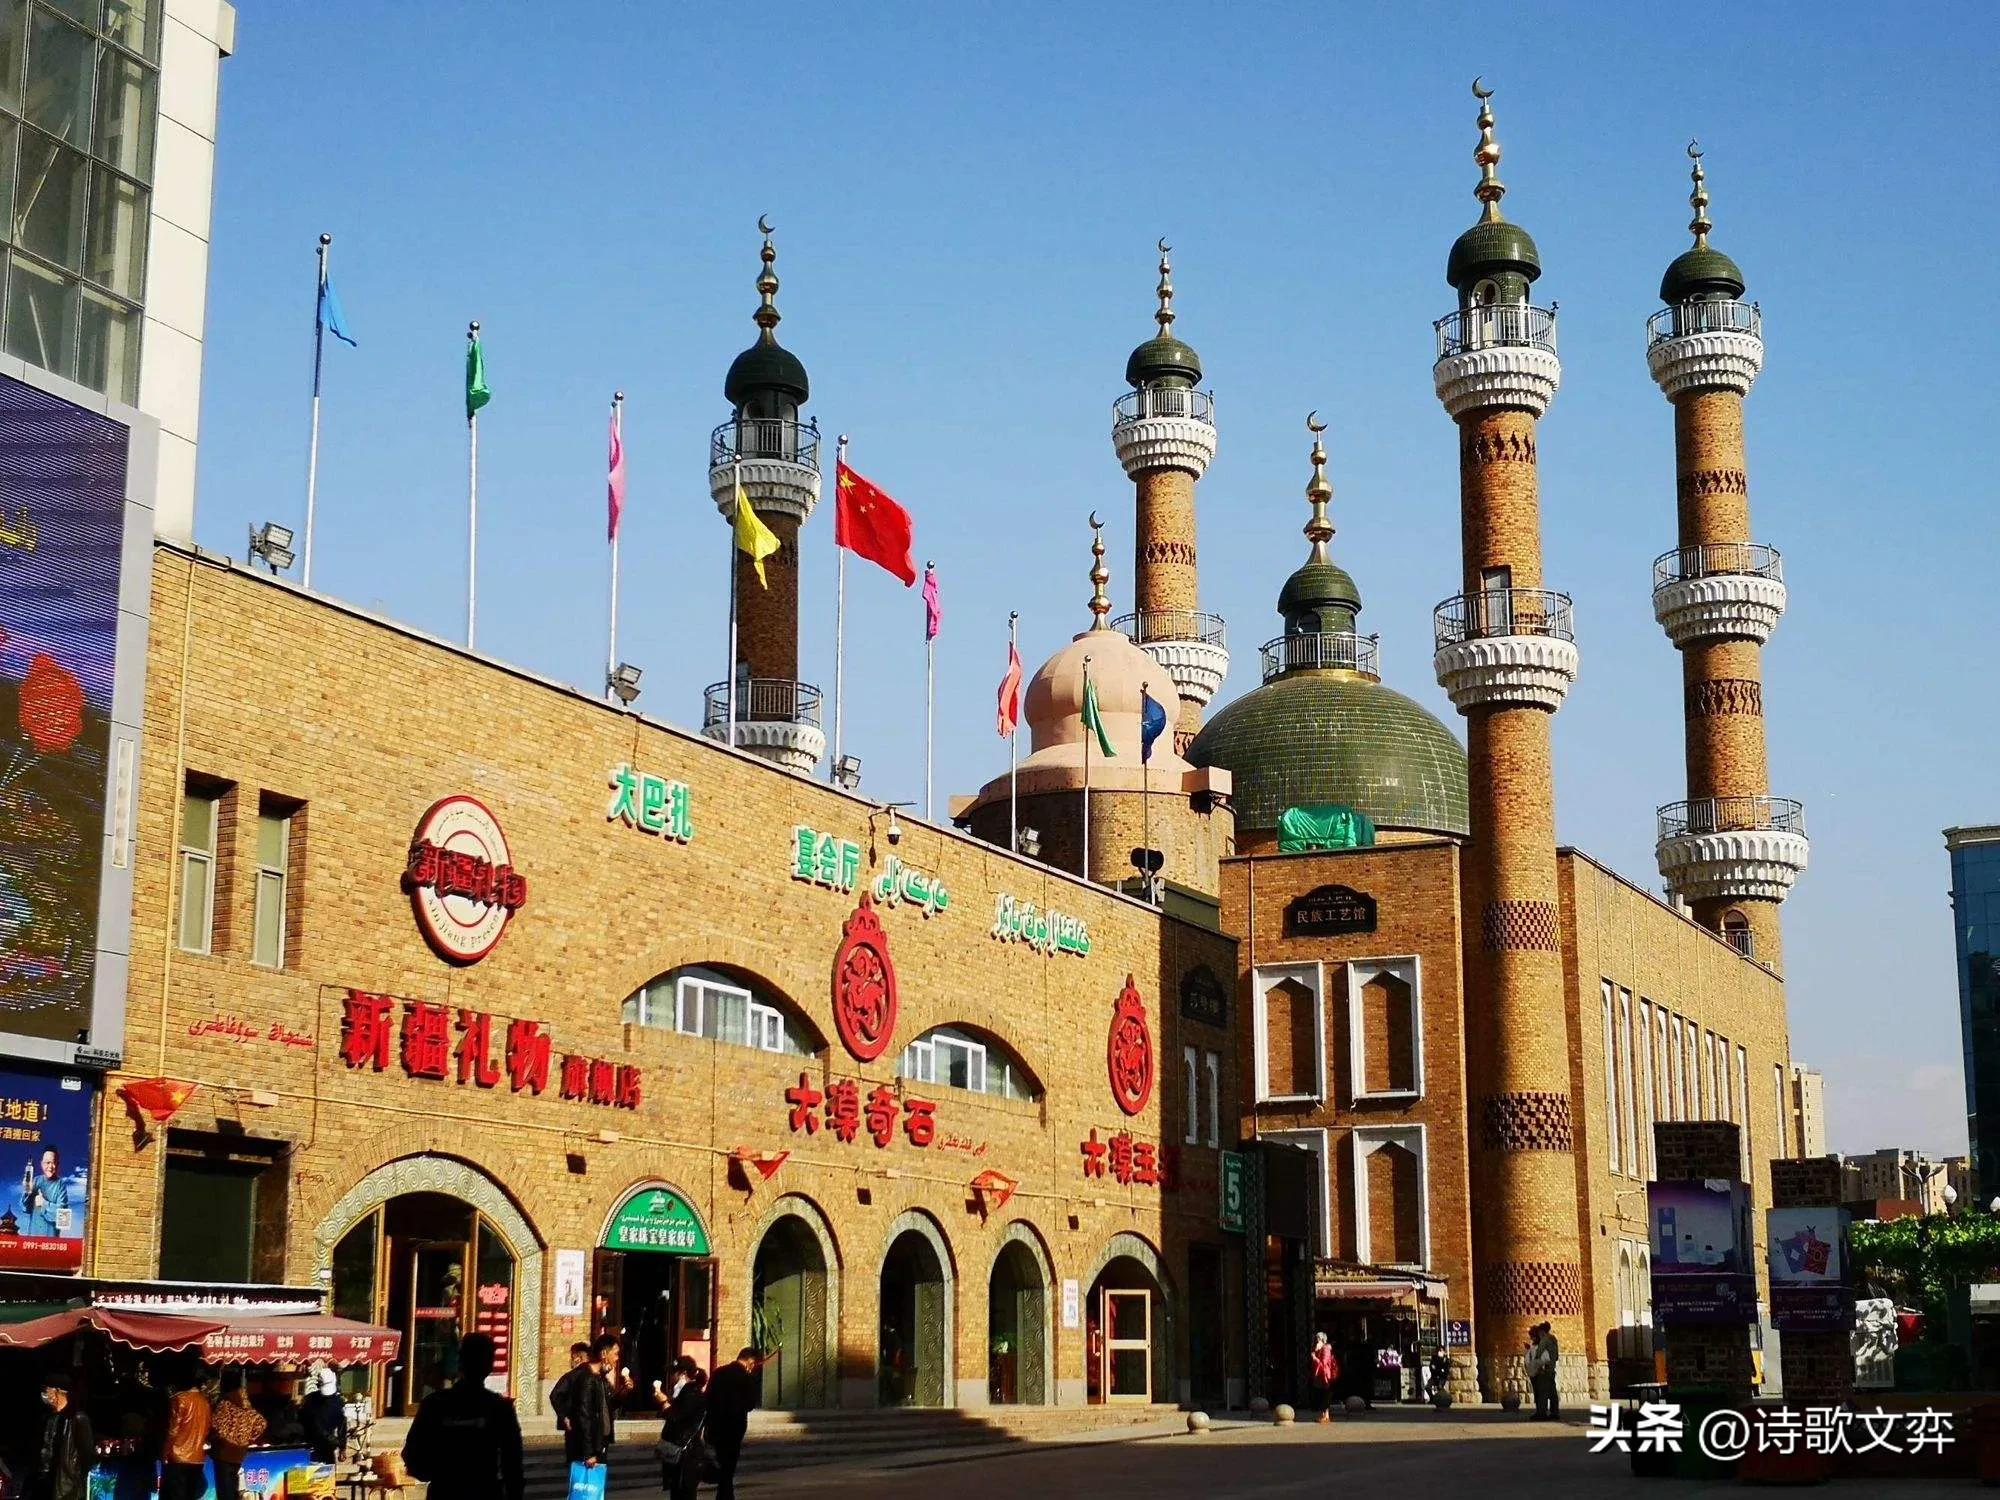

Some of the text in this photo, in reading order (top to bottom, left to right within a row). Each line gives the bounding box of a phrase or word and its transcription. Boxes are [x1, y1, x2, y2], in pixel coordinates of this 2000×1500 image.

[607, 763, 694, 842] 大巴扎
[792, 826, 859, 893] 宴会厅
[1297, 906, 1367, 924] 民族工艺馆
[339, 988, 642, 1110] 新疆礼物 旗舰店
[785, 1073, 937, 1148] 大漠奇石
[1228, 1172, 1240, 1211] 5
